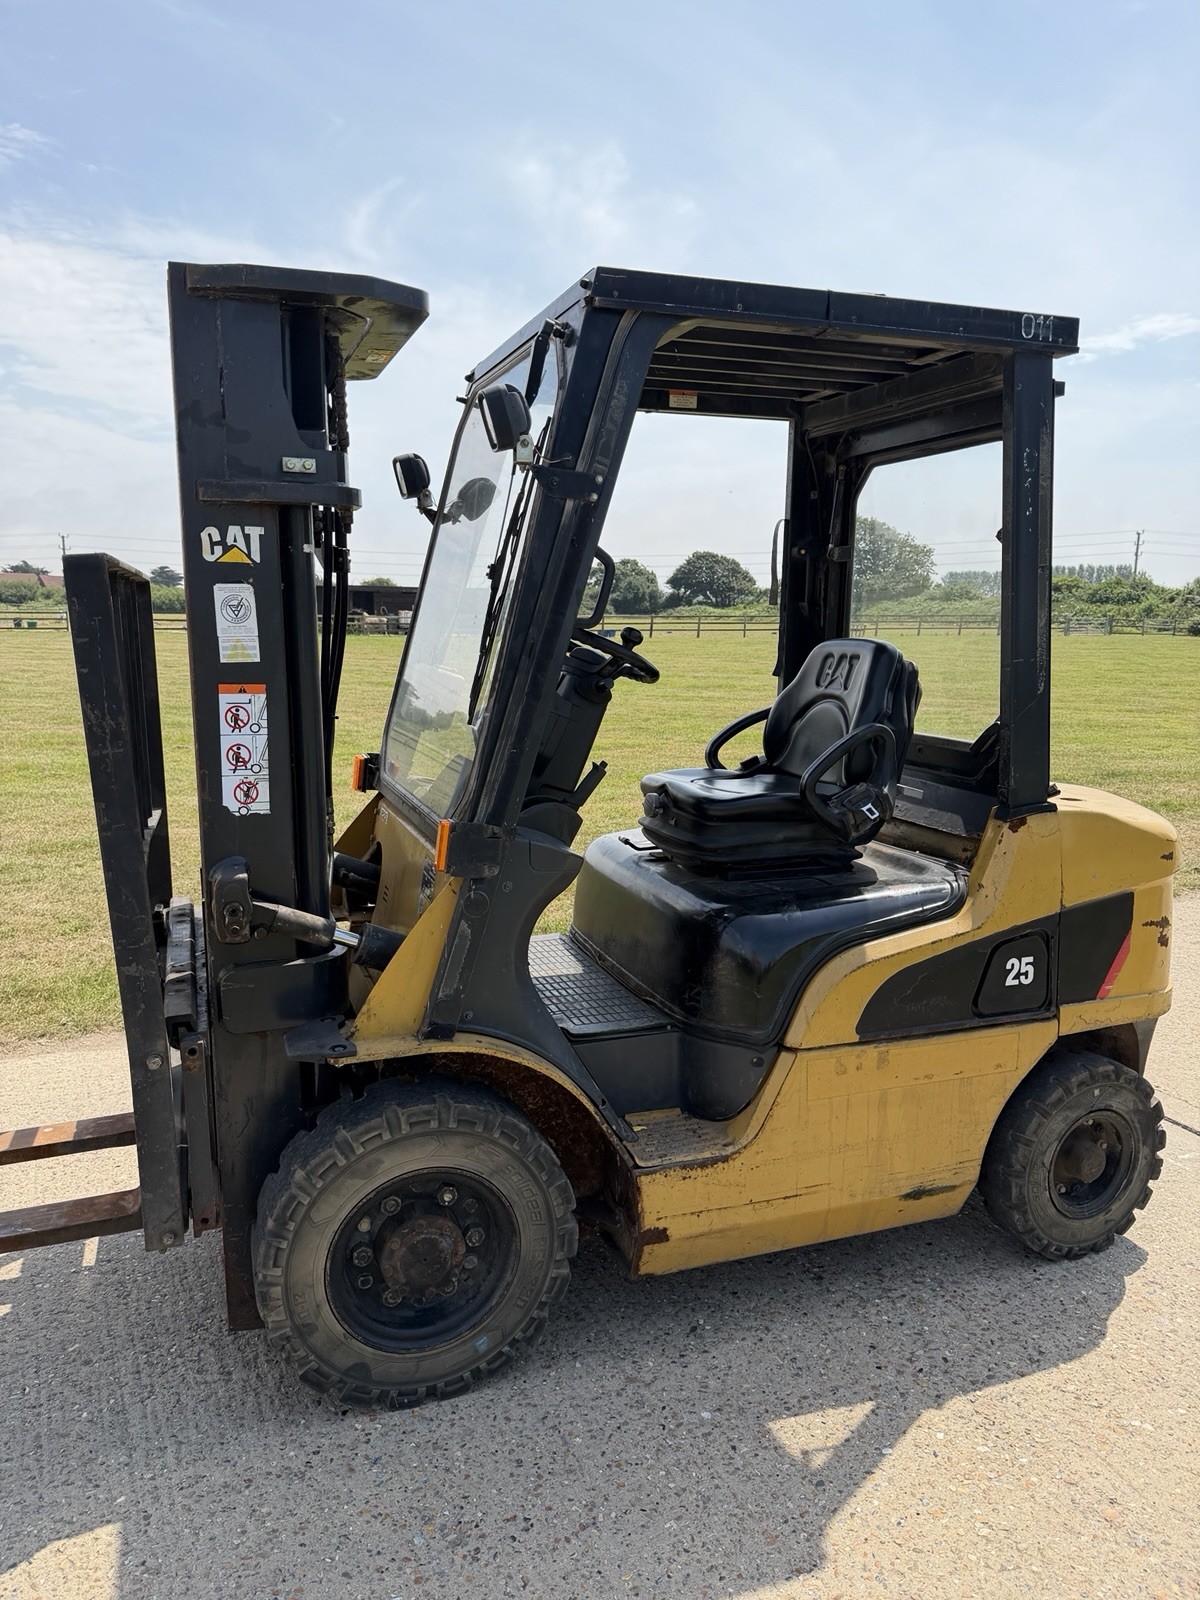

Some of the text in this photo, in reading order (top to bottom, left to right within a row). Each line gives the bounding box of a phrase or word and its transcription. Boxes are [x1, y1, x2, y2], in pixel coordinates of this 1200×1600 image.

[1021, 313, 1054, 342] 011
[200, 525, 265, 564] CAT
[815, 651, 861, 692] CAT
[1004, 956, 1035, 987] 25
